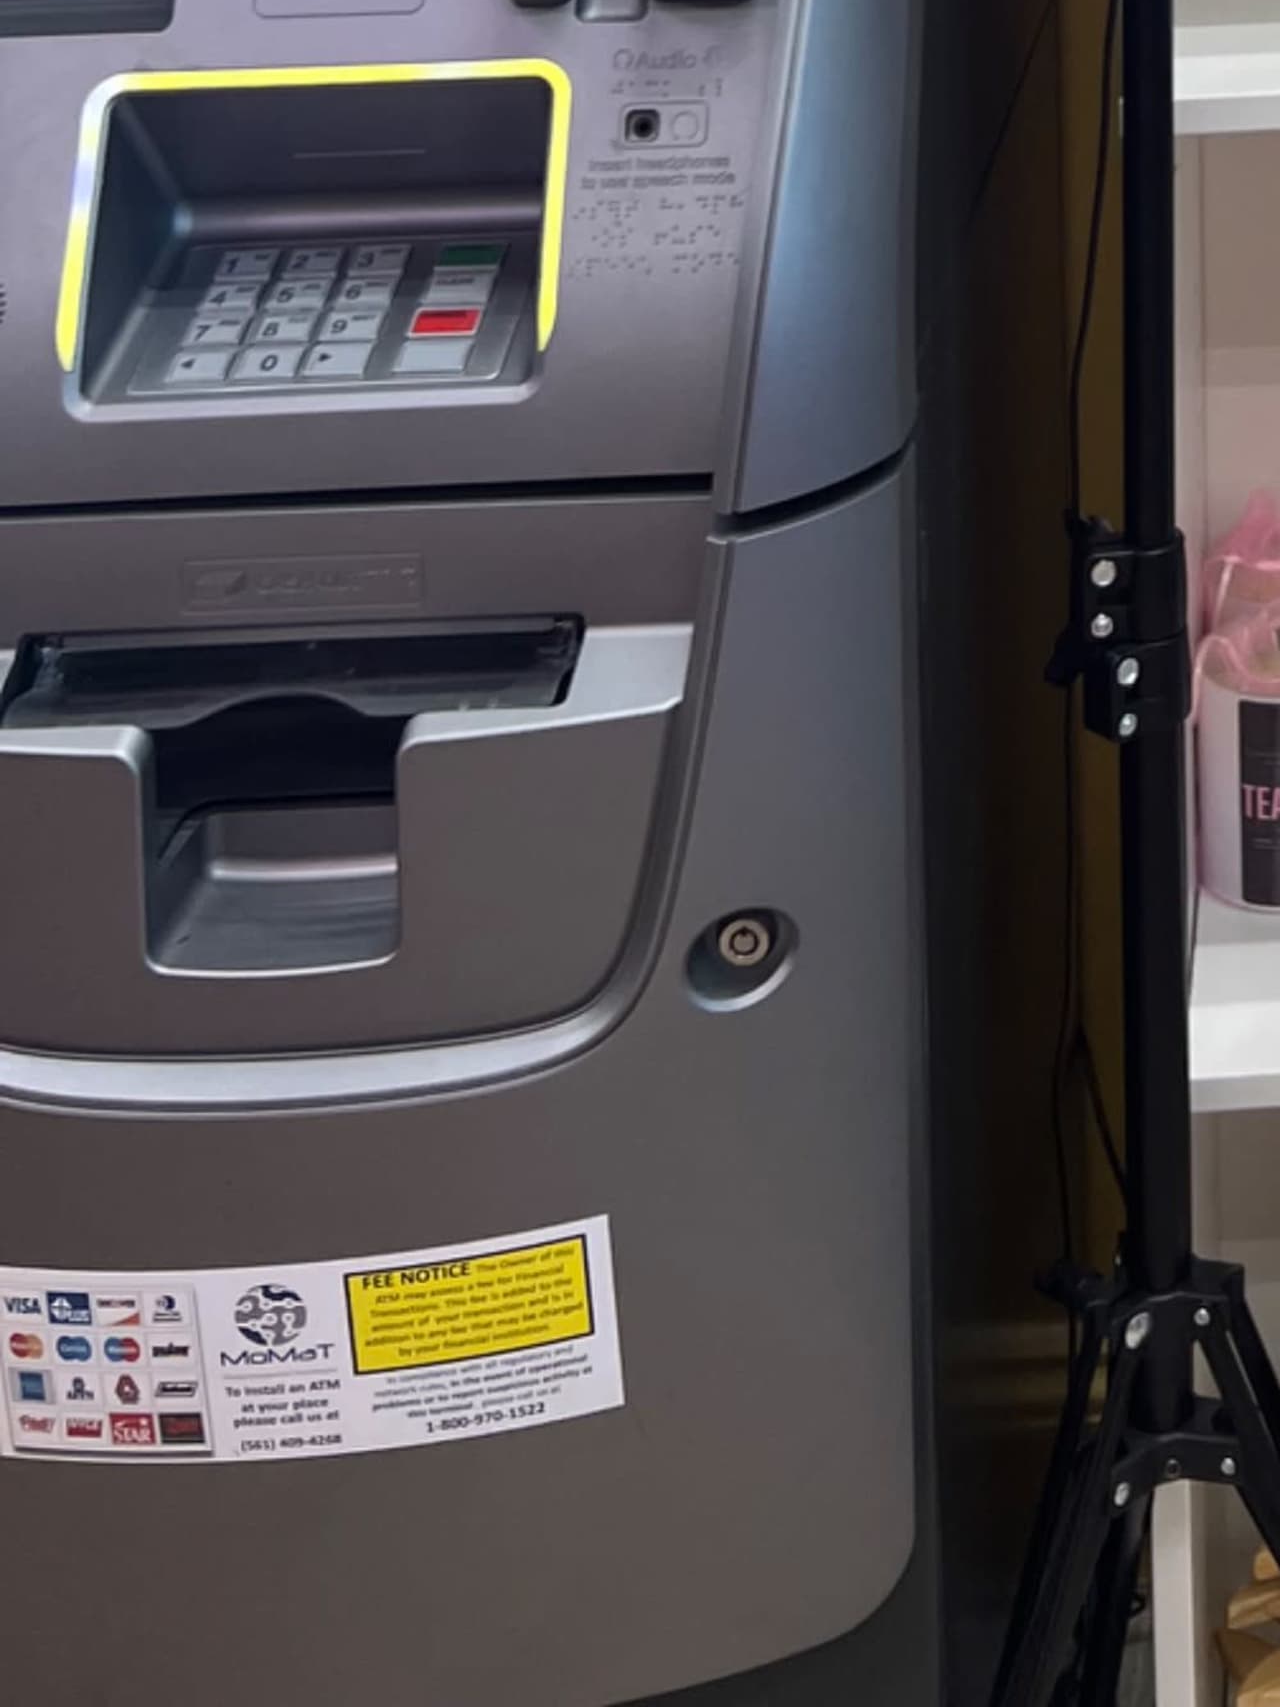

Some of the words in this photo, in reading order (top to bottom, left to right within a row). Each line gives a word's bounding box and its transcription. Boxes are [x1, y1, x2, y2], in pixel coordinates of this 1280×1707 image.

[635, 49, 697, 70] Audio
[225, 258, 239, 273] 1
[292, 255, 310, 269] 2
[357, 252, 375, 268] 3
[208, 290, 227, 305] 4
[275, 289, 294, 303] 5
[345, 285, 362, 300] 6
[194, 324, 212, 340] 7
[262, 322, 280, 337] 8
[331, 319, 348, 334] 9
[259, 355, 279, 372] 0
[361, 1272, 395, 1290] FEE
[400, 1261, 471, 1286] NOTICE
[3, 1295, 42, 1314] VISA
[225, 1386, 241, 1398] To
[244, 1384, 285, 1396] install
[289, 1384, 306, 1393] an
[309, 1379, 341, 1391] ATM
[241, 1404, 255, 1413] at
[258, 1402, 288, 1414] your
[292, 1398, 329, 1411] place
[233, 1416, 277, 1430] please
[280, 1413, 303, 1424] call
[307, 1413, 322, 1422] us
[326, 1410, 340, 1420] at
[425, 1401, 546, 1433] 1-800-970-1522
[113, 1428, 152, 1443] STAR
[240, 1439, 276, 1452] (561)
